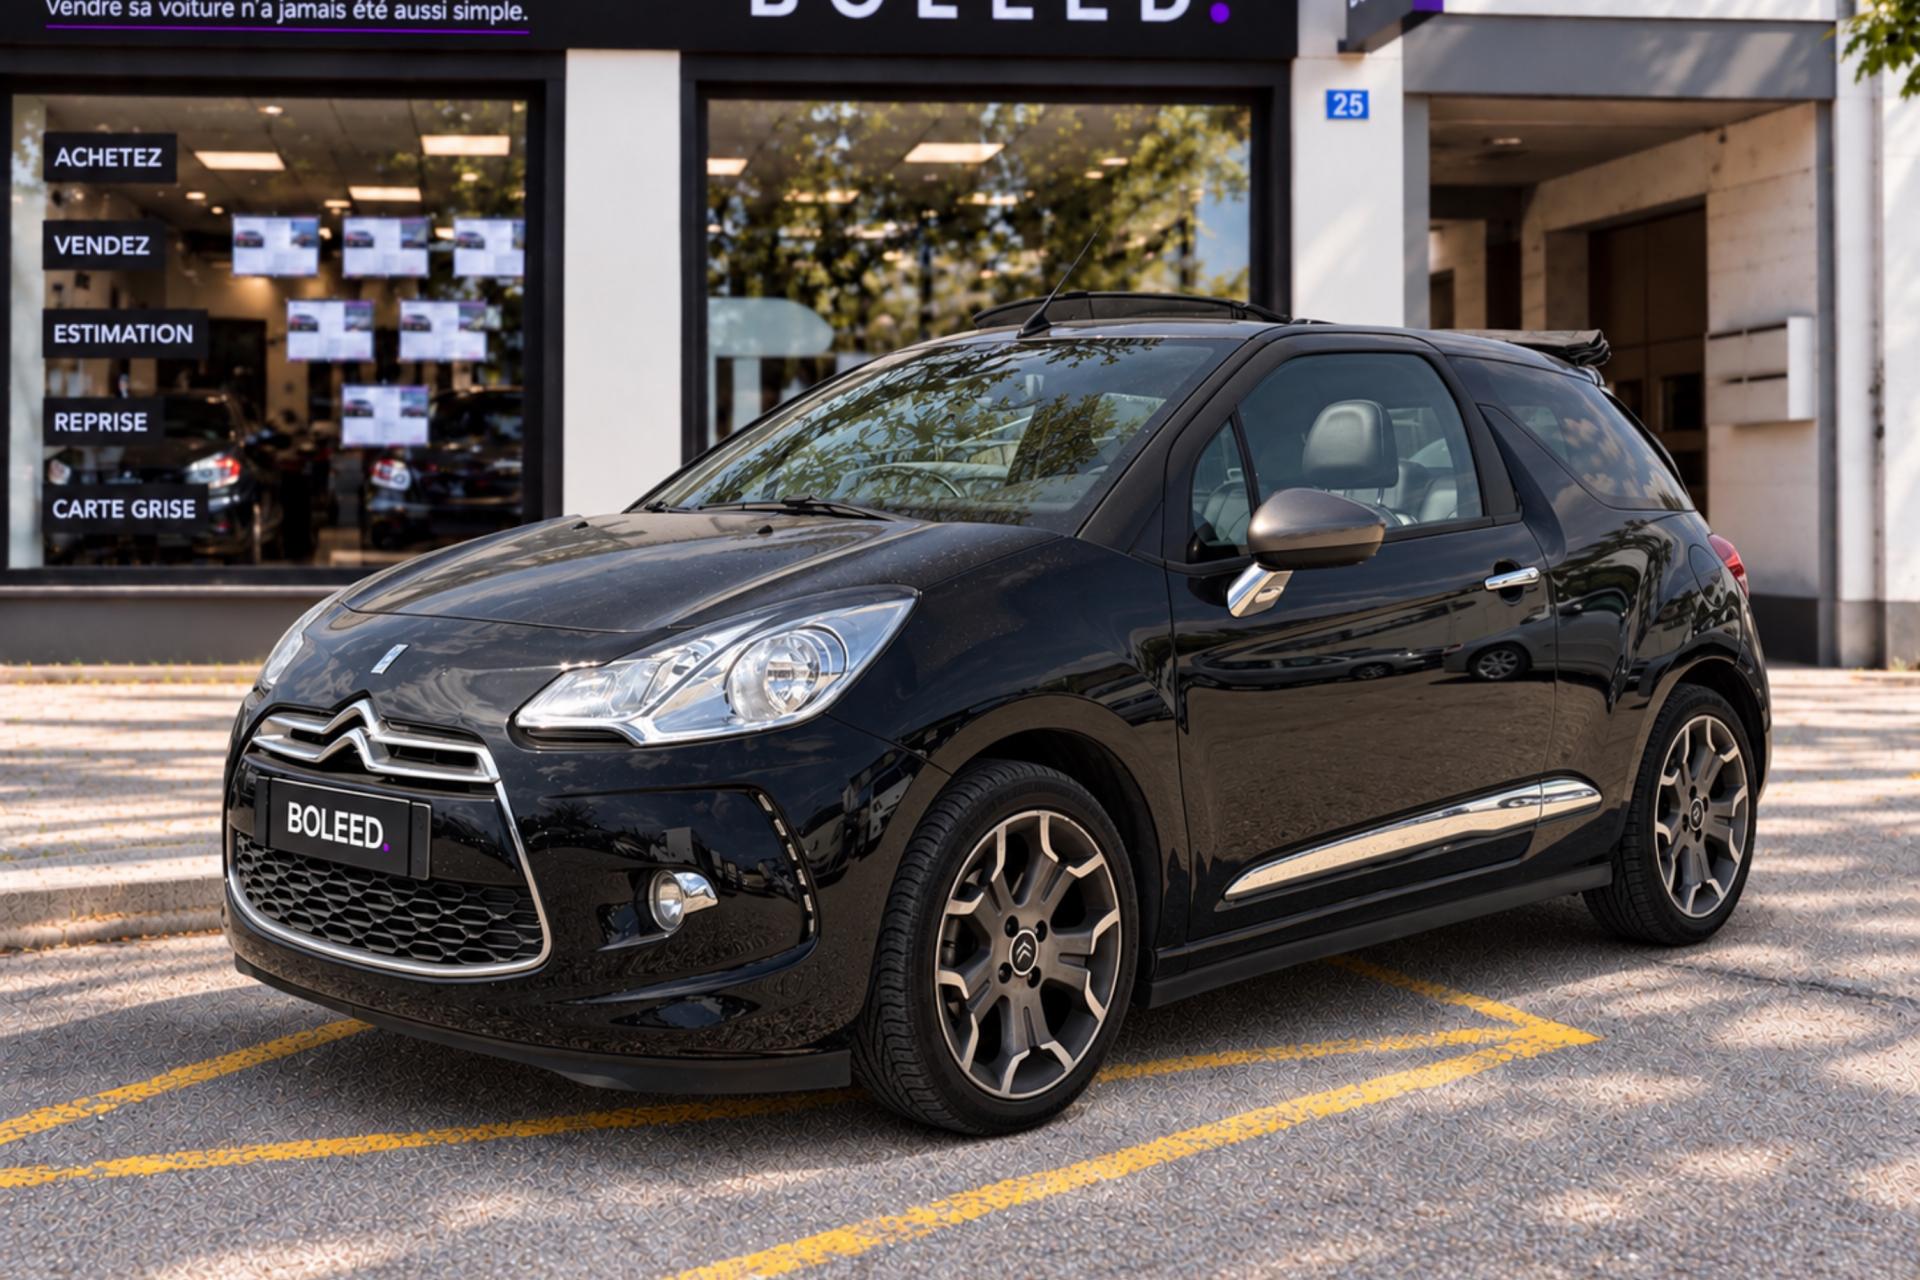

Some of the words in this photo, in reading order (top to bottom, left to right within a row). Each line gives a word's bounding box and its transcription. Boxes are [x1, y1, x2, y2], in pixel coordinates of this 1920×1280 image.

[46, 0, 123, 17] Vendre
[129, 1, 152, 17] sa
[158, 0, 235, 18] voiture
[276, 0, 347, 24] jamais
[352, 0, 388, 20] été
[394, 0, 447, 20] aussi
[453, 0, 528, 25] simple.
[1333, 93, 1364, 117] 25
[54, 147, 162, 168] ACHETEZ
[54, 235, 150, 256] VENDEZ
[54, 323, 193, 344] ESTIMATION
[54, 412, 148, 432] REPRISE
[52, 499, 125, 519] CARTE
[131, 499, 196, 519] GRISE
[287, 800, 390, 853] BOLEED.
